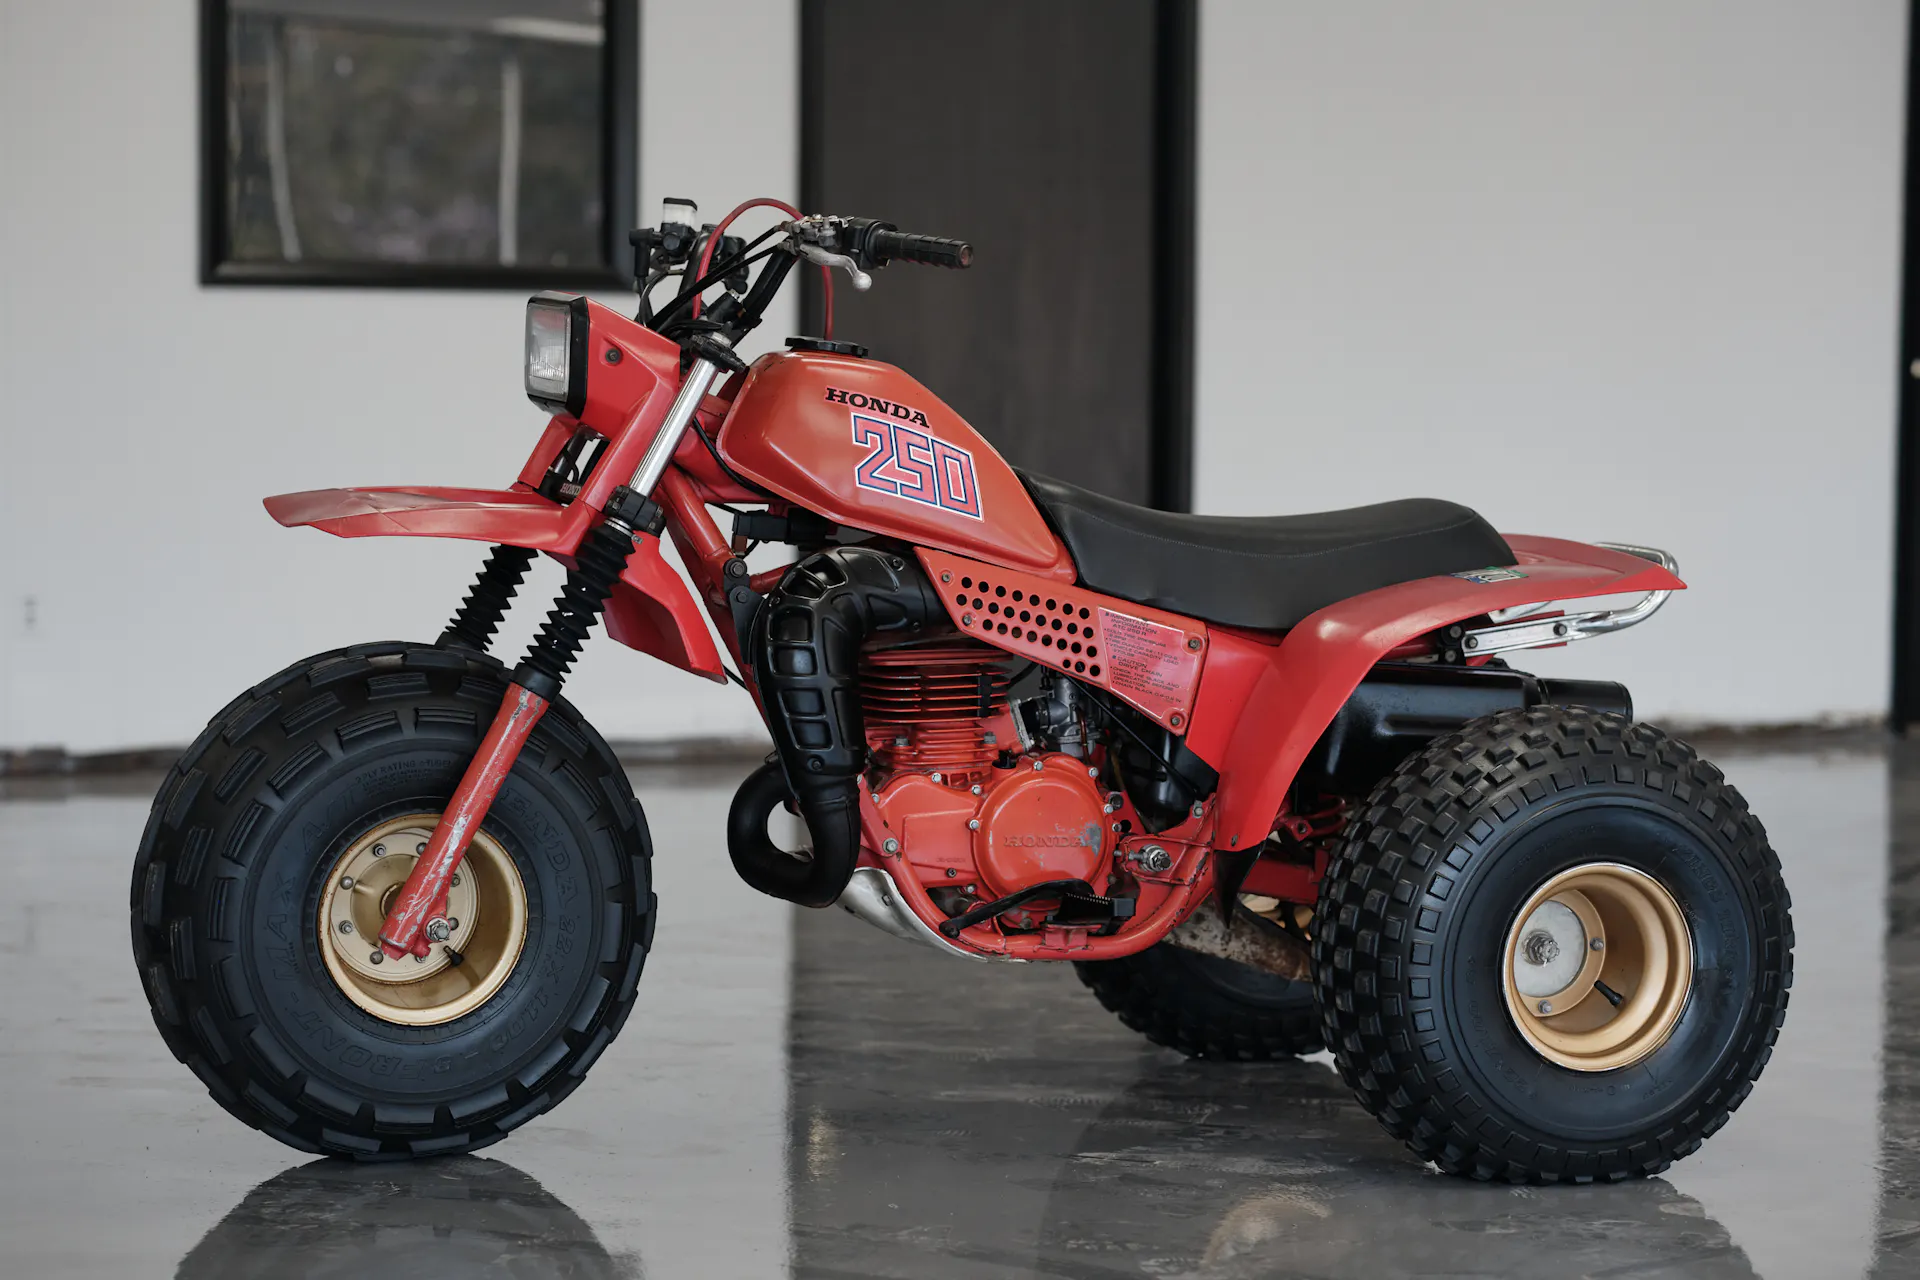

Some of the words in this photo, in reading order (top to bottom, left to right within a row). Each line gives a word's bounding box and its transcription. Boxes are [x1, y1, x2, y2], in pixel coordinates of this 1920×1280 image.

[825, 387, 930, 429] HONDA
[851, 412, 984, 522] 250
[1117, 656, 1147, 668] CAUTION
[1118, 661, 1138, 671] DRIVE
[1141, 668, 1163, 678] CHAIN
[1003, 835, 1090, 848] HONDA
